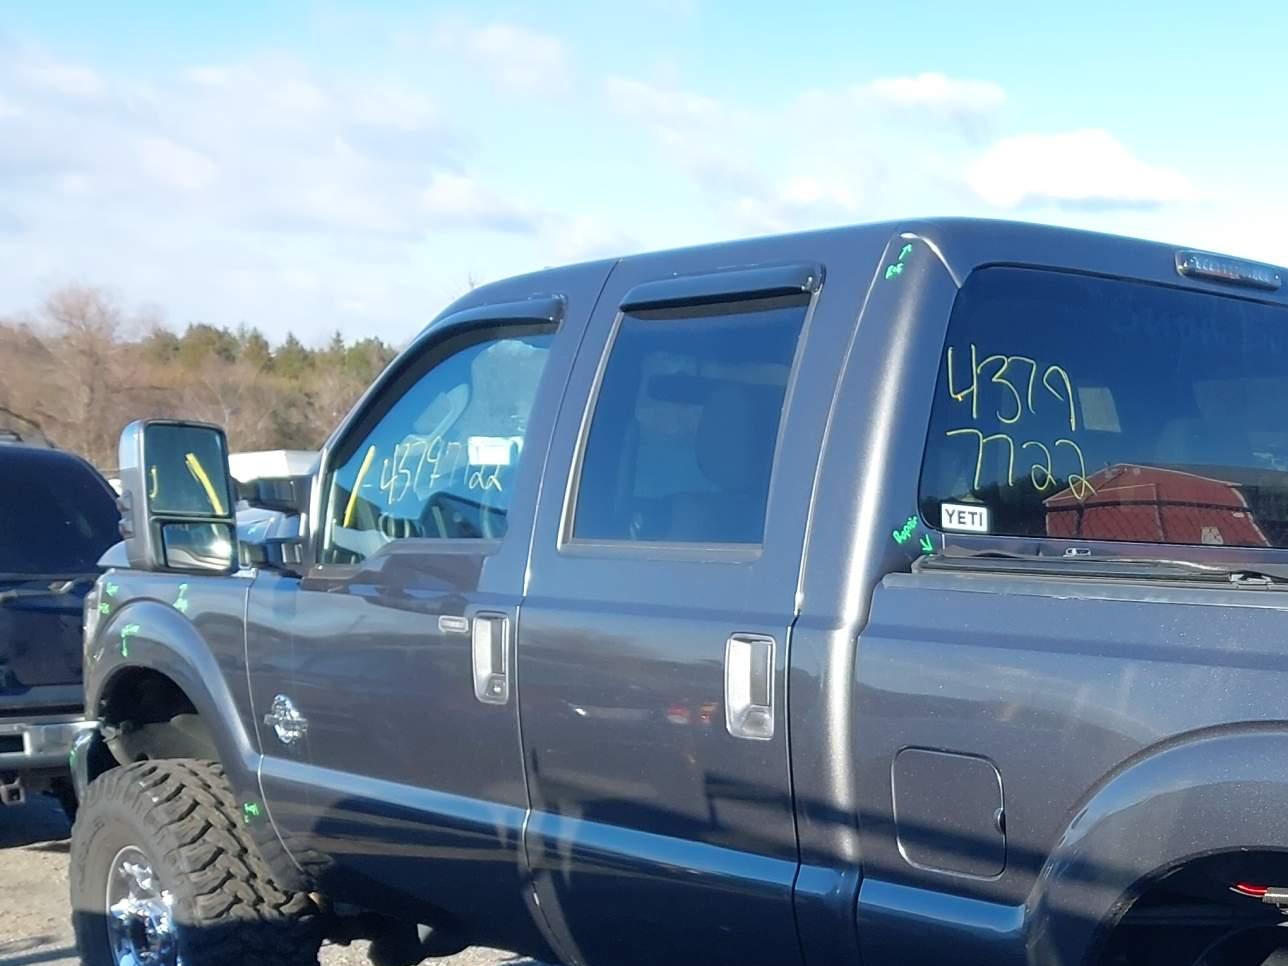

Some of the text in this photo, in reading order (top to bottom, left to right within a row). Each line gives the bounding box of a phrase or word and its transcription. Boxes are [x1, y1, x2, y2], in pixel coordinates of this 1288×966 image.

[948, 343, 1076, 432] 4379
[945, 428, 1098, 500] 7722
[944, 508, 983, 527] YETI
